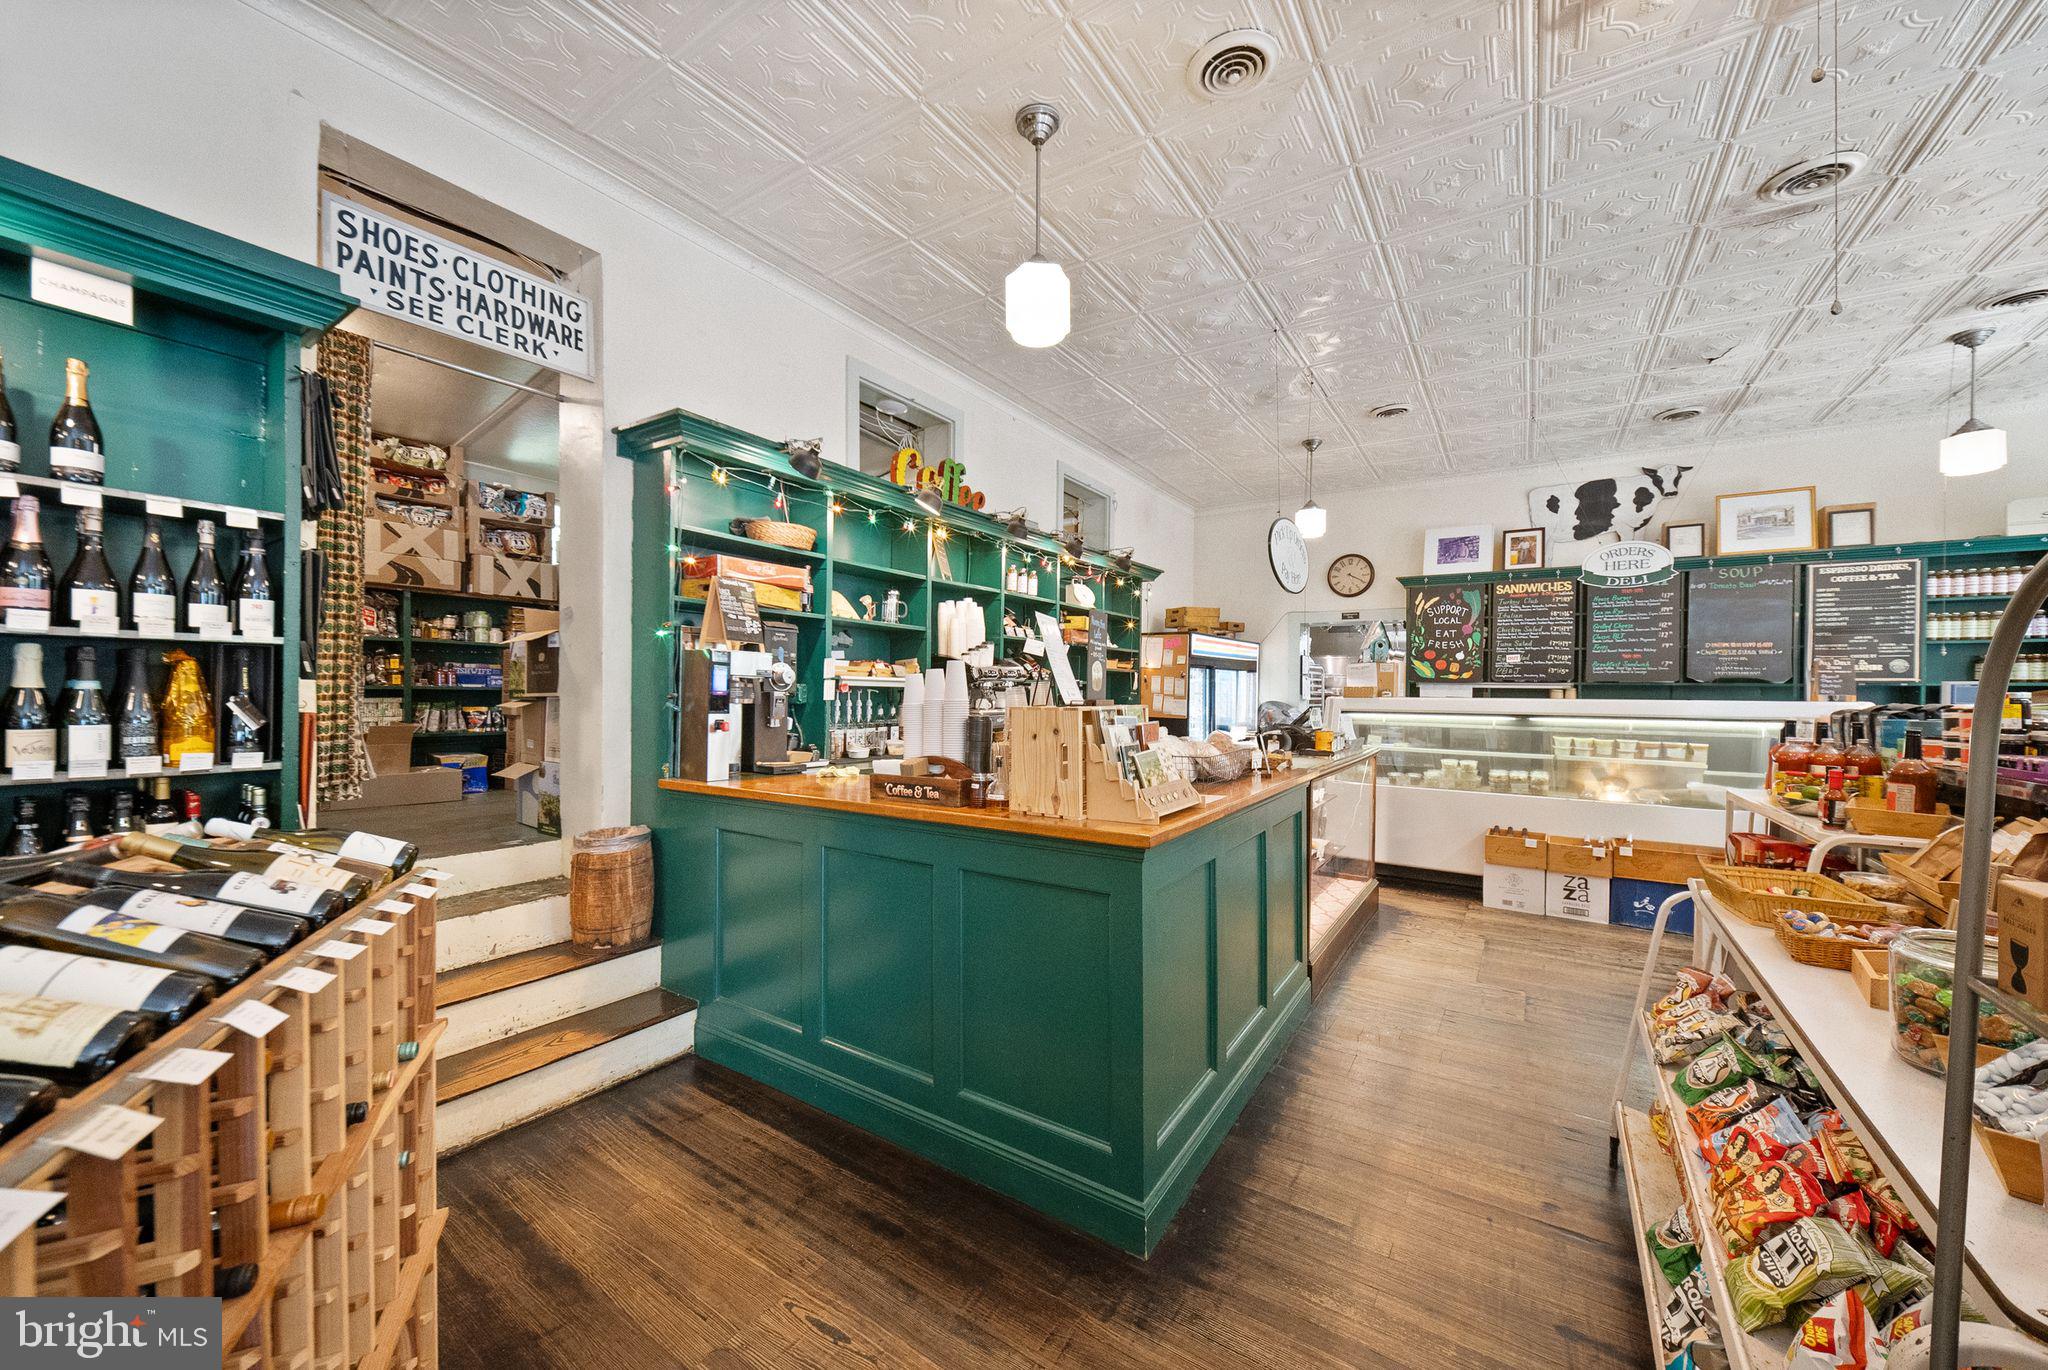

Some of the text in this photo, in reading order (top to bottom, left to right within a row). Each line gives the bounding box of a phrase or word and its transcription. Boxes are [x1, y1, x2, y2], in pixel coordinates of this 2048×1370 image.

[337, 209, 582, 323] SHOES CLOTHING
[37, 276, 127, 308] CHAMPAGNE
[337, 240, 584, 352] PAINTS HARDWARE
[387, 290, 547, 360] SEE CLERK
[890, 447, 986, 511] Coffee
[1600, 547, 1656, 561] ORDERS
[1605, 559, 1652, 571] HERE
[1819, 563, 1912, 575] ESPRESSO DRINKS,
[1718, 566, 1763, 579] SOUP
[1831, 575, 1868, 583] COFFEE
[1605, 575, 1649, 586] DELI
[1496, 581, 1573, 595] SANDWICHES
[1427, 604, 1469, 617] SUPPORT
[1433, 616, 1462, 624] LOCAL
[1435, 630, 1457, 638] EAT
[1428, 639, 1464, 649] FRESH
[885, 783, 940, 799] Coffee & Tea
[1563, 875, 1590, 890] za
[1563, 888, 1590, 903] za
[1787, 1226, 1814, 1264] ROUTE
[1775, 1237, 1800, 1273] 11
[1760, 1251, 1784, 1286] CHIPS
